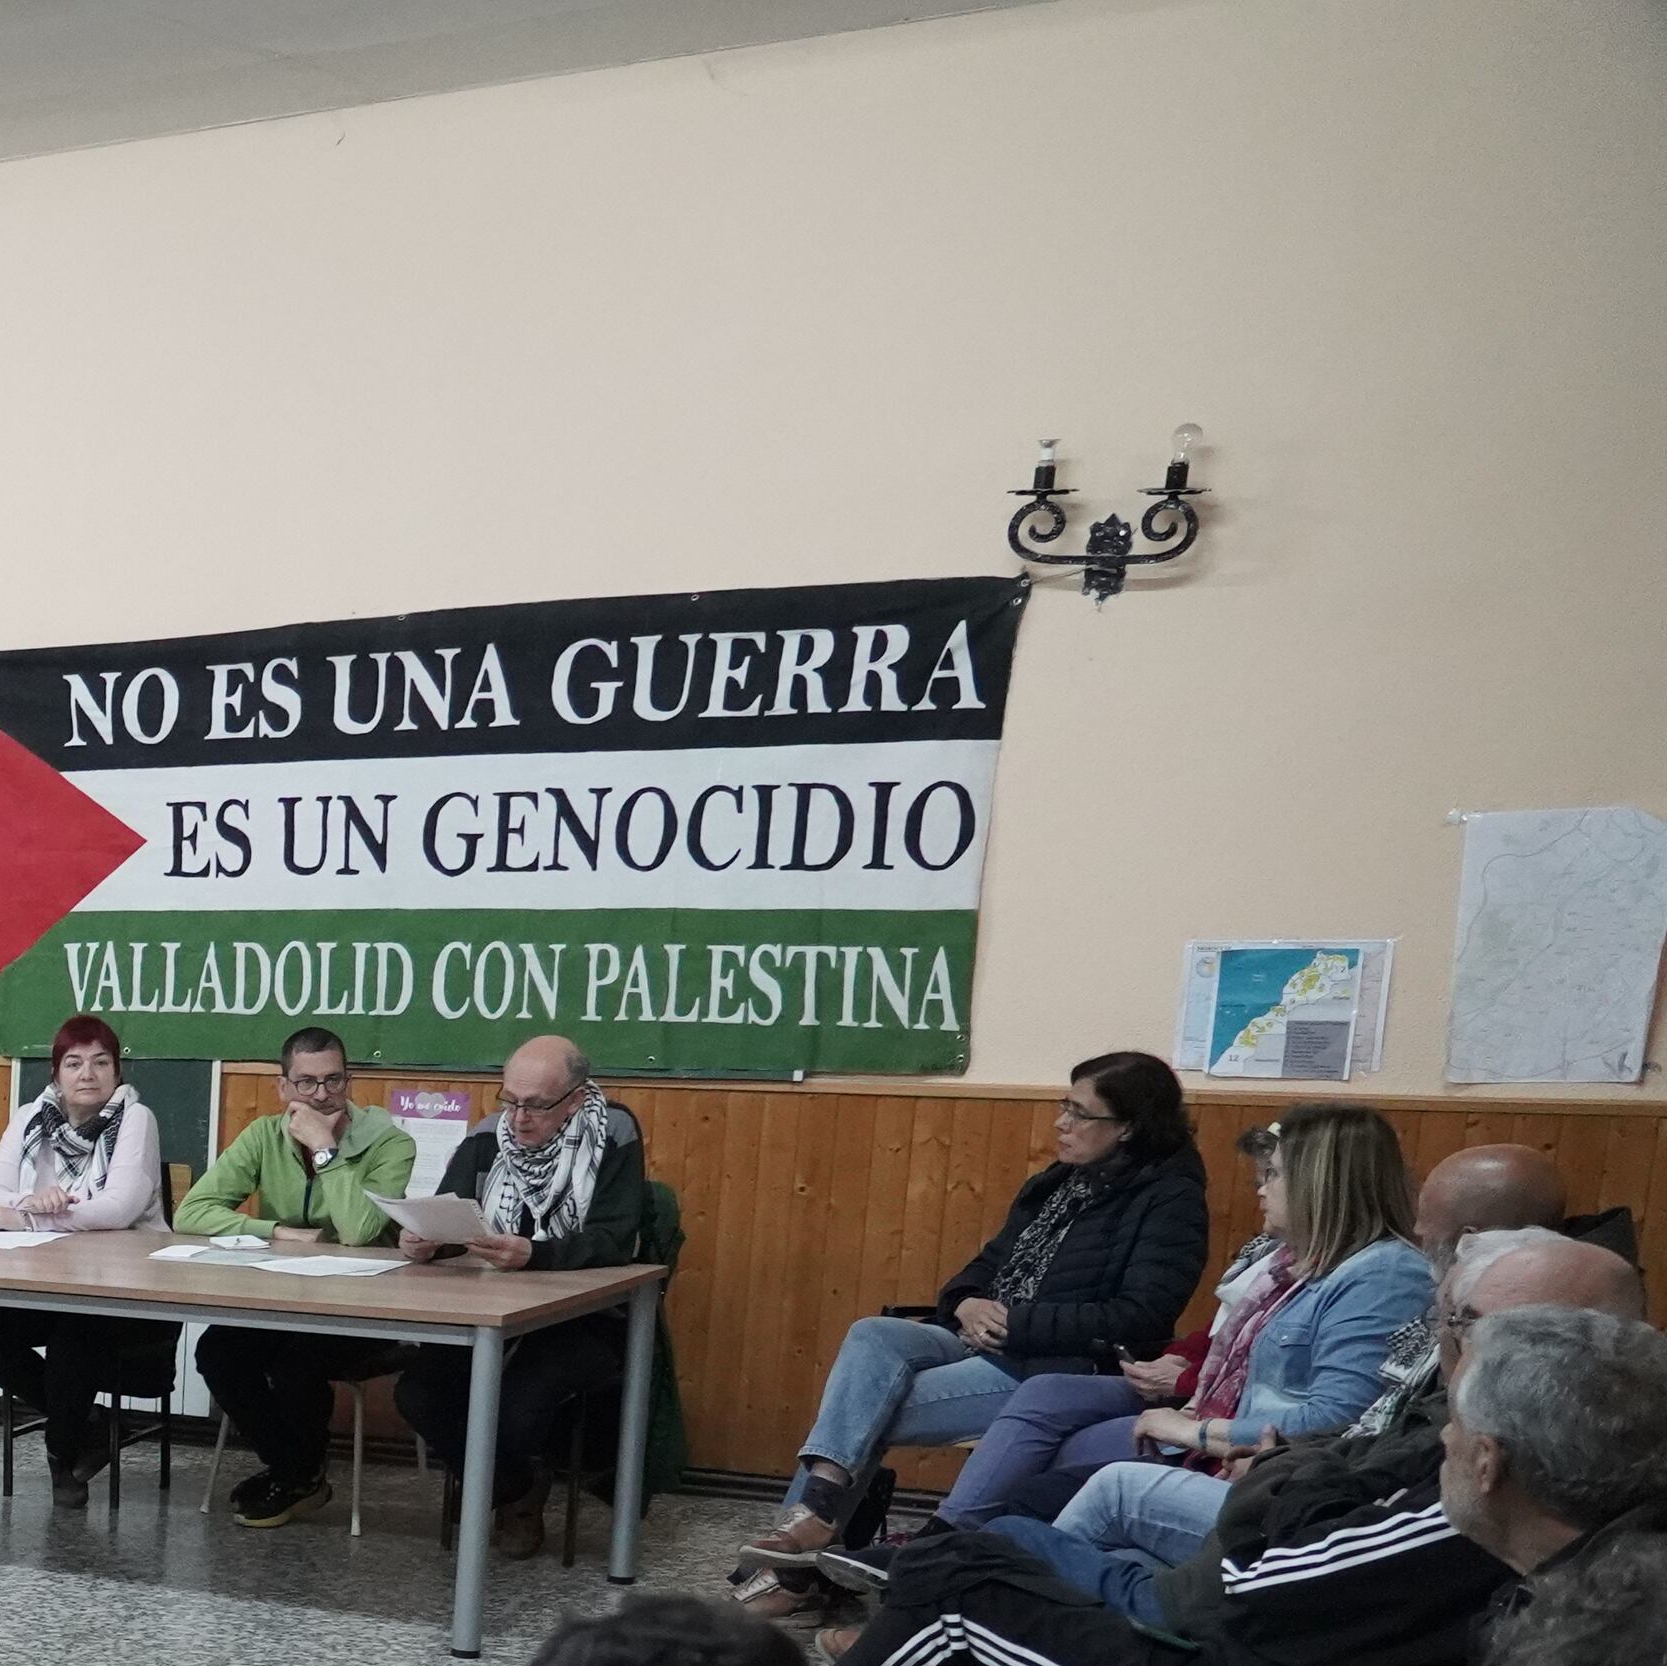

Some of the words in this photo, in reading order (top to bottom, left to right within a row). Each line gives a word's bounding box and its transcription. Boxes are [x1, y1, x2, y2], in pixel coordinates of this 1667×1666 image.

[62, 667, 180, 748] NO
[204, 656, 302, 740] ES
[326, 642, 520, 735] UNA
[551, 619, 986, 725] GUERRA
[164, 799, 252, 878] ES
[278, 794, 397, 875] UN
[422, 780, 976, 877] GENOCIDIO
[63, 940, 413, 1016] VALLADOLID
[431, 940, 564, 1020] CON
[581, 943, 961, 1033] PALESTINA
